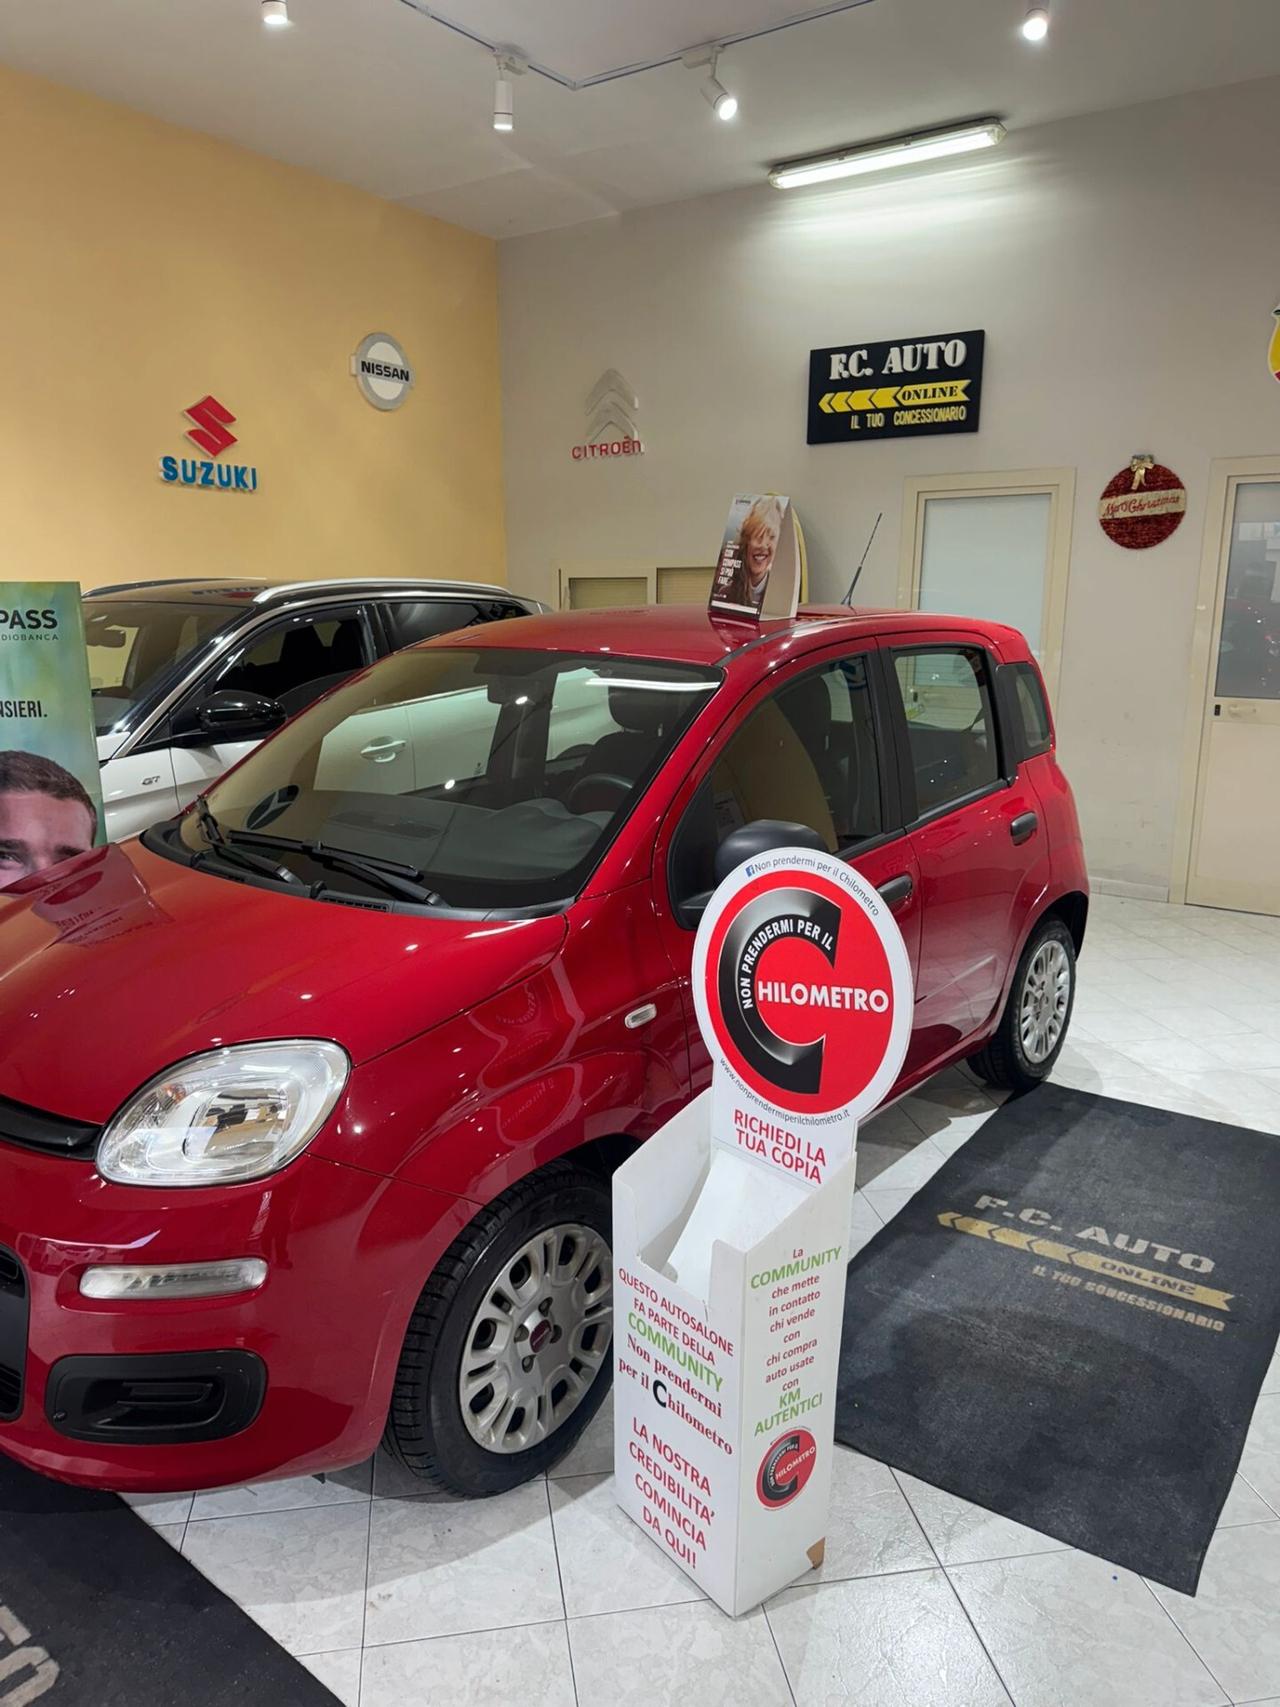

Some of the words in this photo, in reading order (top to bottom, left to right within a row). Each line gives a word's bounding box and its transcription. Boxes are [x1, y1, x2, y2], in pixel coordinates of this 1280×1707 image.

[361, 360, 410, 382] NISSAN
[829, 350, 874, 380] F.C.
[882, 339, 967, 375] AUTO
[901, 385, 959, 401] ONLINE
[851, 415, 861, 429] IL
[866, 412, 885, 428] TUO
[893, 406, 966, 426] CONCESSIONARIO
[160, 455, 257, 491] SUZUKI
[754, 860, 774, 872] Non
[773, 856, 815, 868] prendermi
[816, 861, 831, 872] per
[832, 867, 839, 876] il
[839, 871, 879, 917] Chilometro
[741, 918, 794, 974] PRENDERMI
[797, 919, 821, 940] PER
[821, 932, 834, 951] IL
[740, 977, 754, 1010] NON
[720, 1057, 850, 1127] www.nonprendermiperilchilometro.it
[734, 1108, 801, 1154] RICHIEDI
[806, 1141, 826, 1168] LA
[736, 1128, 767, 1157] TUA
[771, 1146, 822, 1184] COPIA
[750, 1246, 842, 1289] COMMUNITY
[792, 1248, 804, 1259] La
[1075, 1226, 1216, 1274] AUTO
[771, 1286, 790, 1299] che
[791, 1275, 820, 1292] mette
[1101, 1261, 1197, 1296] ONLINE
[618, 1267, 658, 1303] QUESTO
[660, 1297, 734, 1357] AUTOSALONE
[768, 1306, 778, 1317] in
[780, 1290, 821, 1312] contatto
[769, 1319, 784, 1333] chi
[786, 1307, 816, 1326] vende
[634, 1298, 646, 1316] FA
[648, 1308, 679, 1340] PARTE
[682, 1332, 716, 1366] DELLA
[783, 1331, 801, 1344] con
[628, 1312, 723, 1393] COMMUNITY
[765, 1368, 788, 1383] auto
[789, 1355, 815, 1373] usate
[766, 1352, 780, 1367] chi
[782, 1339, 818, 1360] compra
[627, 1333, 650, 1363] Non
[654, 1359, 722, 1419] prendermi
[782, 1378, 799, 1391] con
[618, 1358, 638, 1380] per
[641, 1372, 649, 1390] il
[652, 1379, 733, 1455] Chilometro
[754, 1392, 823, 1437] AUTENTICI
[779, 1387, 801, 1409] KM
[633, 1417, 649, 1444] LA
[652, 1433, 712, 1497] NOSTRA
[635, 1473, 706, 1551] COMINCIA
[643, 1505, 661, 1536] DA
[665, 1528, 696, 1569] QUI!
